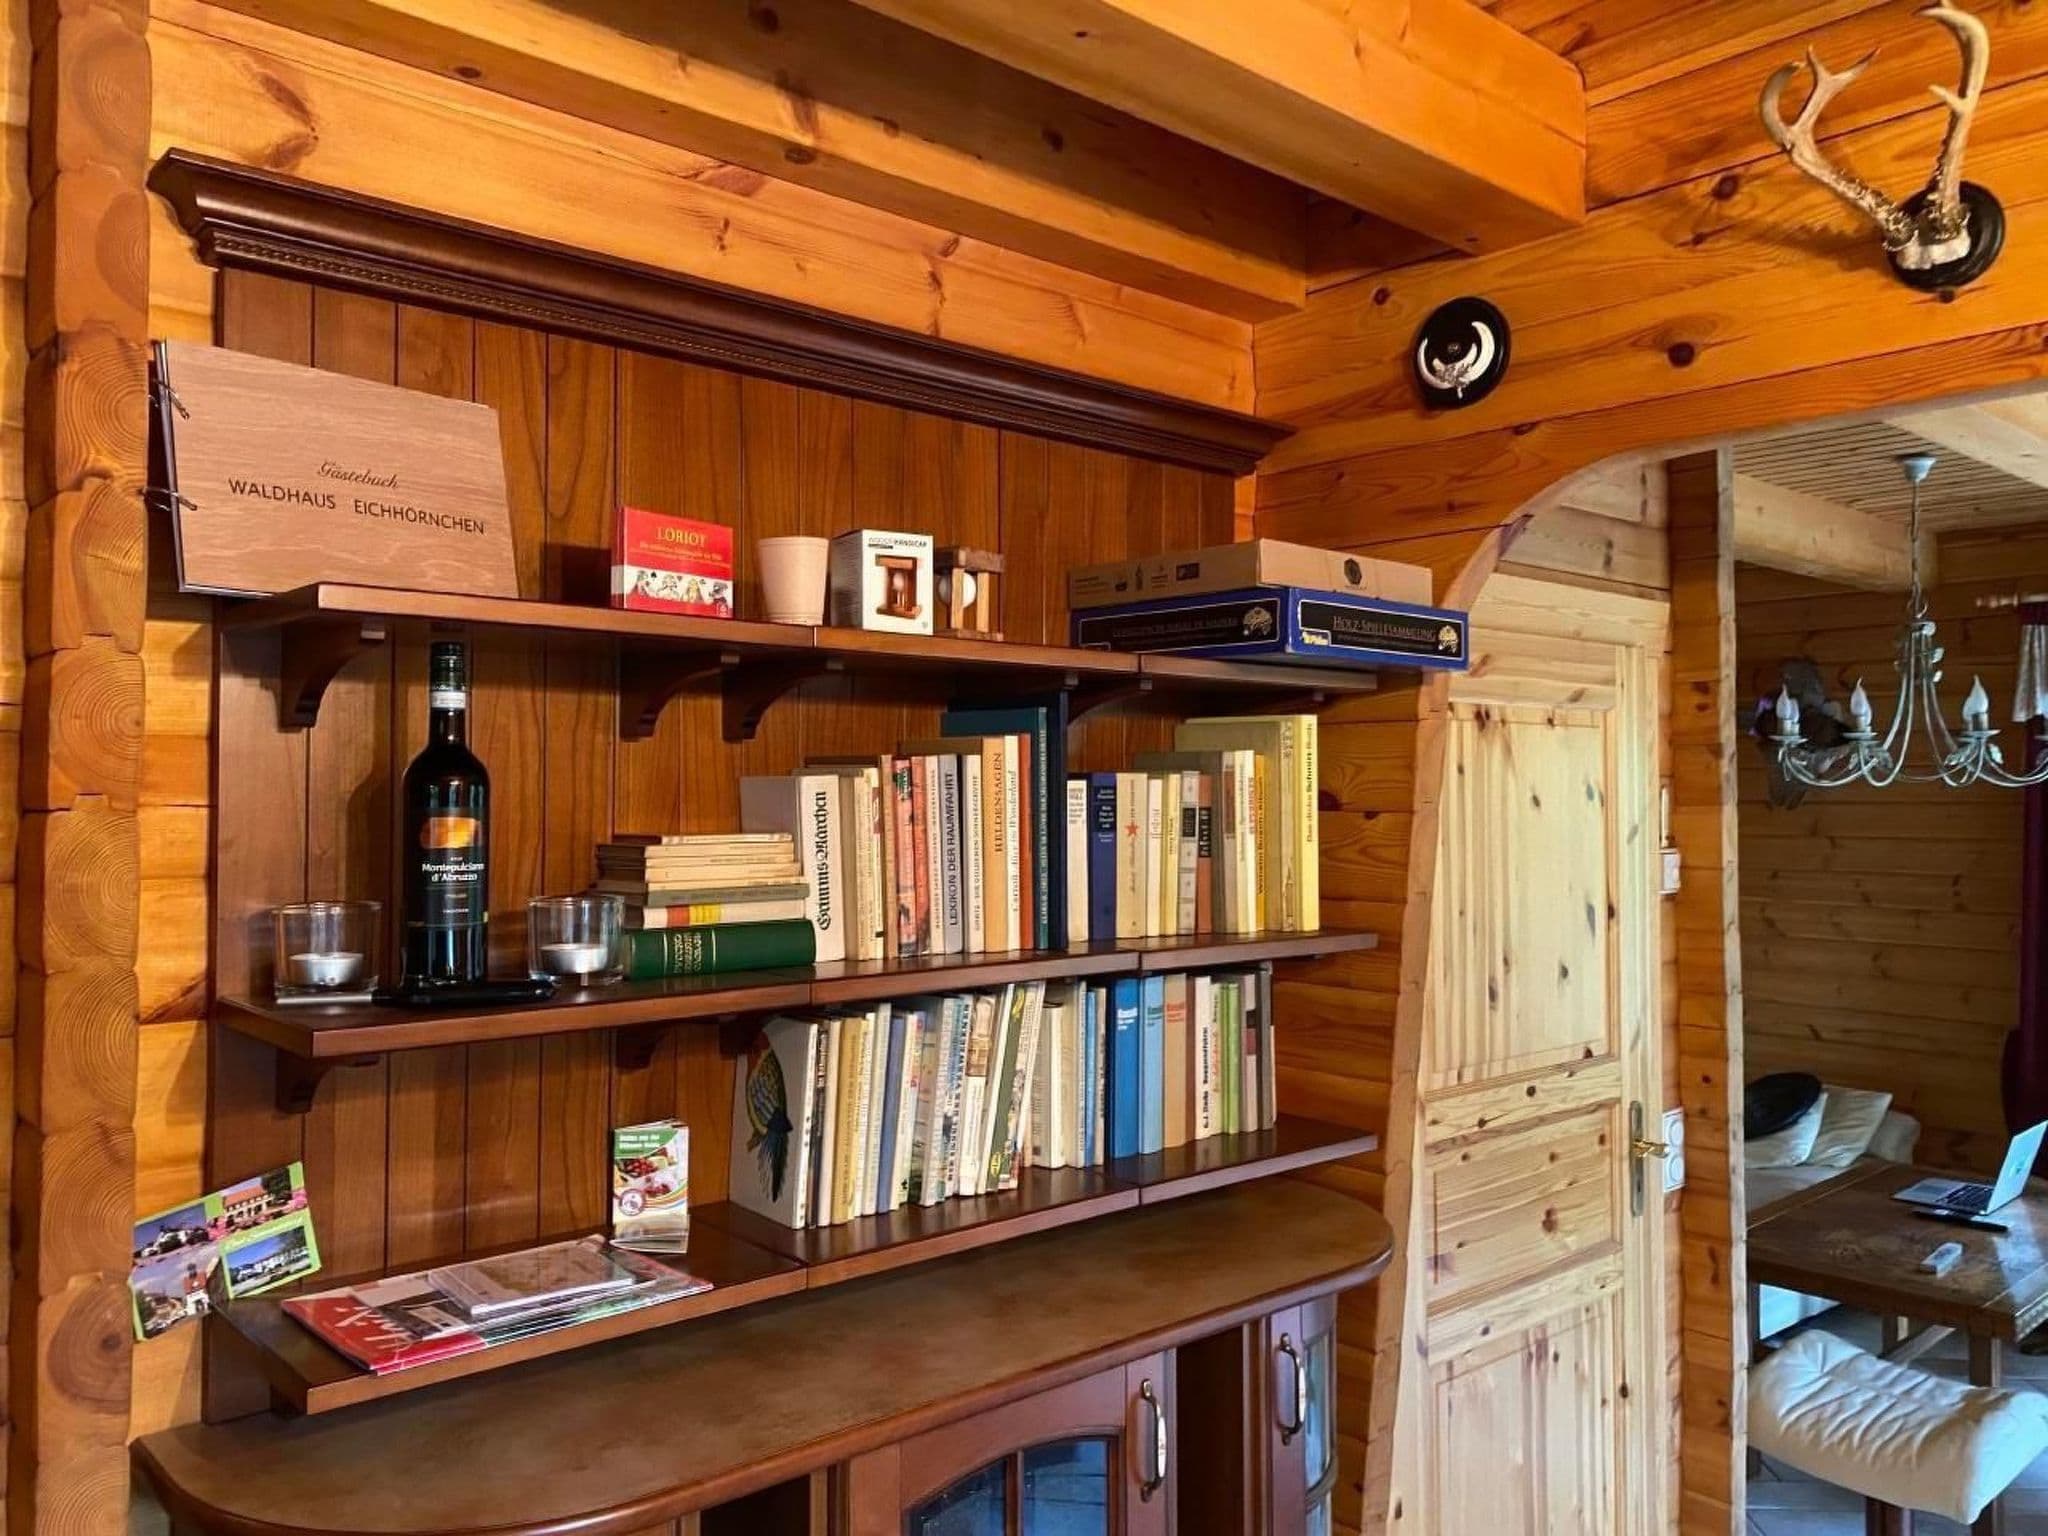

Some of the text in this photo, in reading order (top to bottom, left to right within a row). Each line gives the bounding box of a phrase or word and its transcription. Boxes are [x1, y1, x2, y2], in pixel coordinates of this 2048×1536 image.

[317, 460, 398, 489] Gästebuch
[228, 477, 336, 509] WALDHAUS
[657, 527, 708, 547] LORIOT
[993, 752, 1003, 853] HELDENSAGEN
[813, 790, 833, 931] Grimms Märchen
[944, 773, 959, 926] LEXIKON DER RAUMFAHRT
[421, 862, 485, 873] Montepulciano
[431, 873, 478, 882] d'Abruzzo
